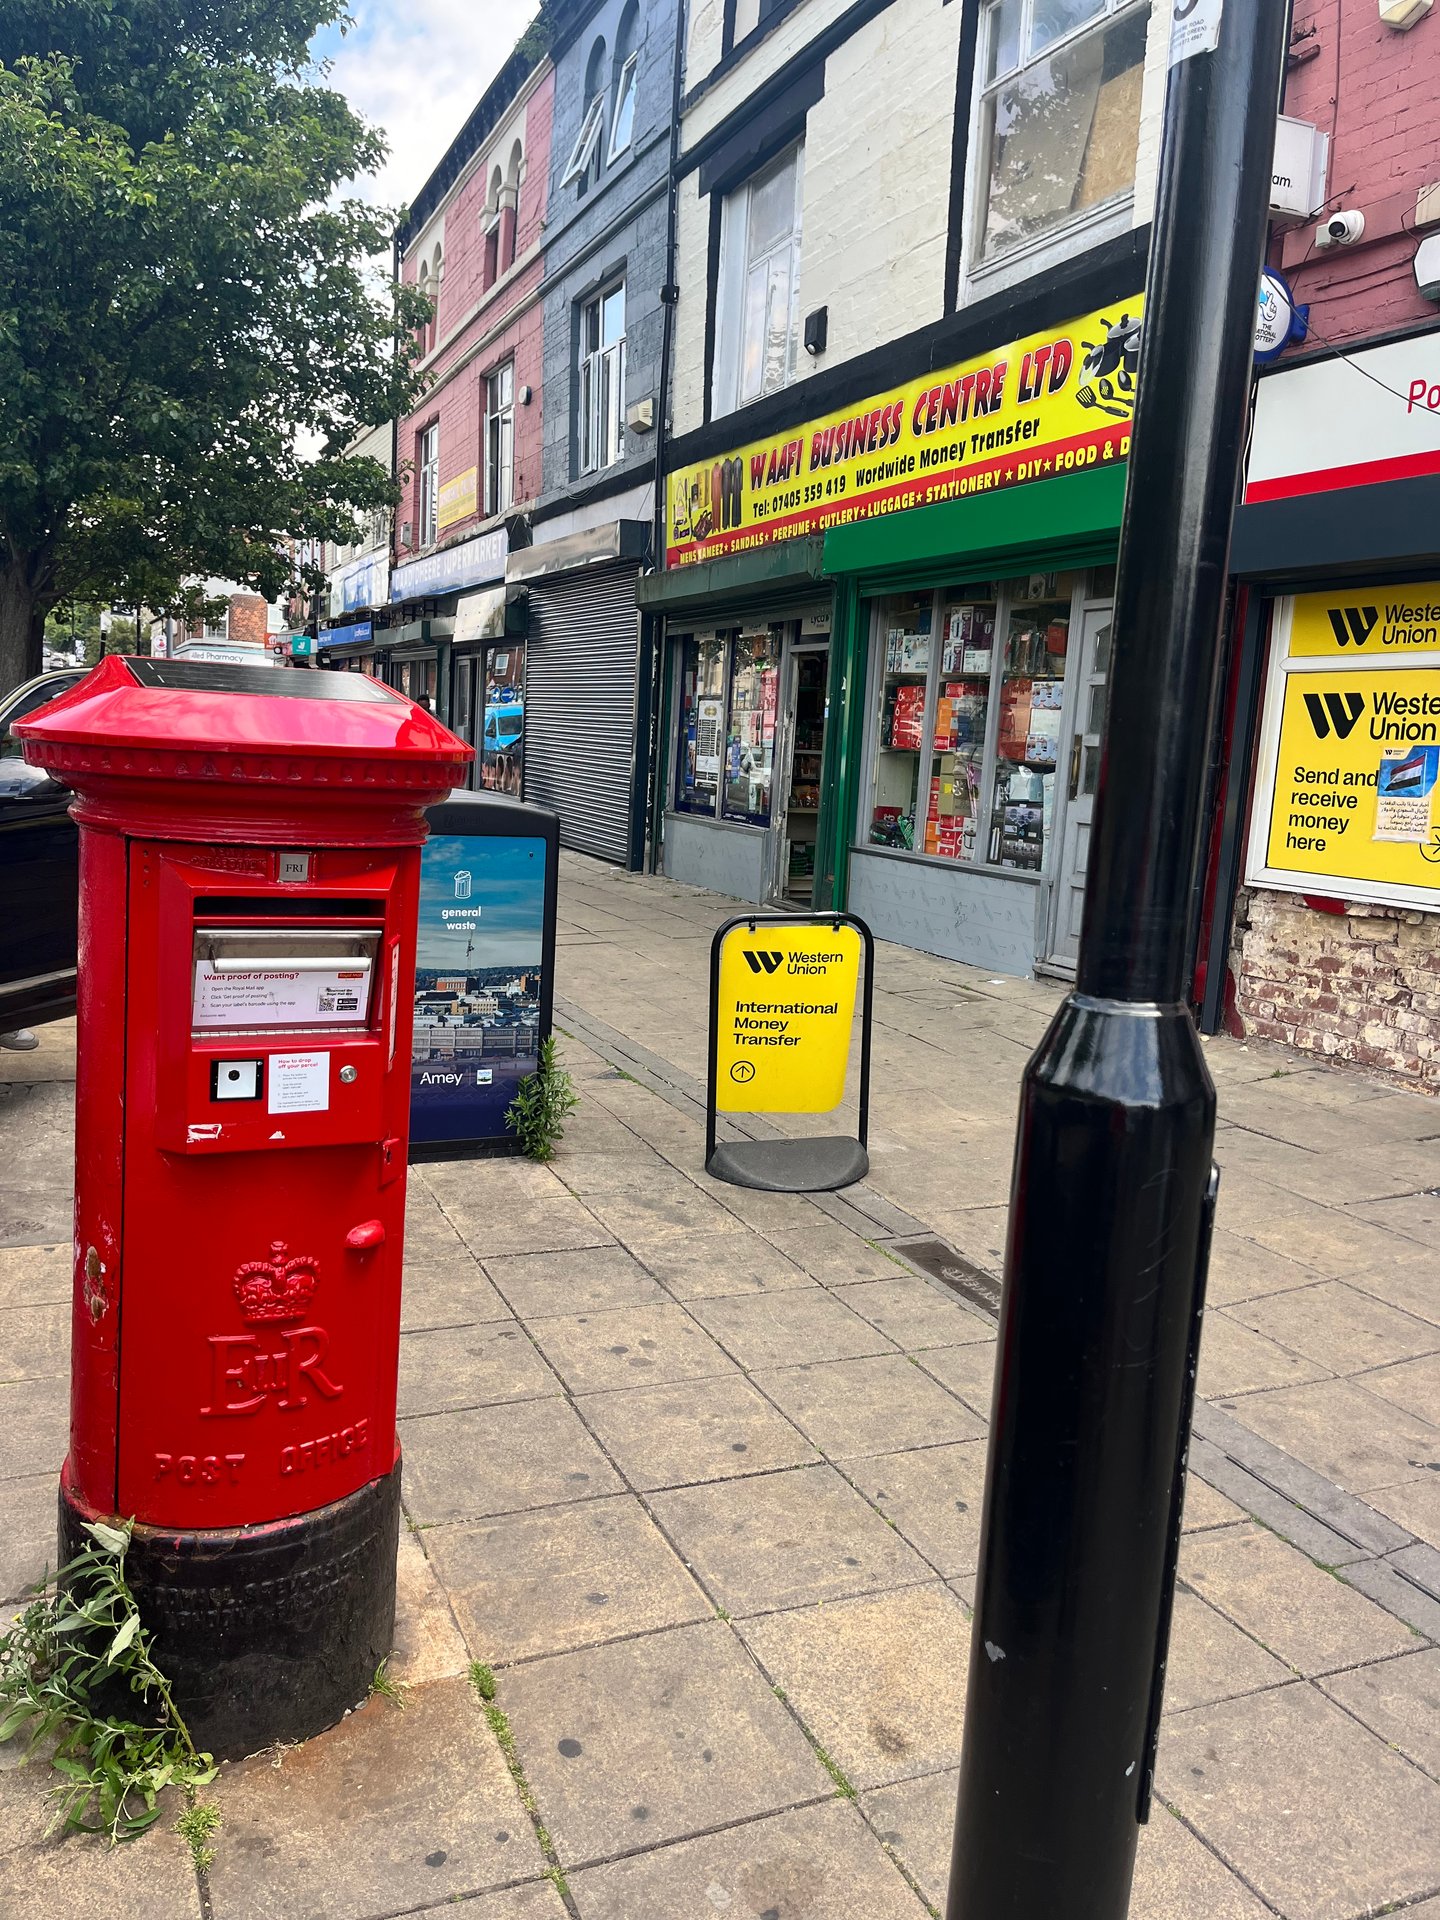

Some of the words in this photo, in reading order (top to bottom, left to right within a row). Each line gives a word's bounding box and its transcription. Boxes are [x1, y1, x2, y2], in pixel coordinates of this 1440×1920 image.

[1256, 328, 1276, 339] ATIONAL
[1262, 323, 1272, 331] THE
[1255, 334, 1274, 344] OTTERY
[750, 438, 804, 492] WAAFI
[809, 400, 904, 473] BUSINESS
[912, 361, 1008, 438] CENTRE
[1017, 339, 1073, 405] LTD
[753, 503, 770, 518] Tel:
[772, 489, 801, 513] 07405
[804, 484, 822, 502] 359
[826, 475, 846, 496] 419
[856, 455, 915, 487] Wordwide
[920, 440, 967, 469] Money
[971, 418, 1040, 452] Transfer
[730, 532, 764, 552] SANDALS
[772, 520, 810, 542] PERFUME
[819, 506, 859, 530] CUTLERY
[868, 493, 915, 516] LUGGAGE
[926, 469, 1002, 503] STATIONERY
[1018, 458, 1042, 481] DIY
[1055, 445, 1098, 472] FOOD
[1102, 440, 1114, 458] &
[443, 533, 503, 576] SUPERMARKET
[1385, 603, 1440, 624] Weste
[1382, 624, 1437, 645] Union
[206, 652, 244, 663] Pharmacy
[1372, 692, 1440, 715] Weste
[1370, 717, 1437, 741] Union
[1294, 766, 1340, 785] Send
[1343, 769, 1380, 787] and
[1291, 791, 1358, 809] receive
[1288, 813, 1350, 835] money
[1286, 832, 1327, 852] here
[286, 864, 304, 872] FRI
[442, 906, 482, 920] general
[446, 920, 476, 930] waste
[788, 952, 843, 963] Western
[227, 973, 250, 981] proof
[264, 972, 300, 980] posting?
[787, 964, 826, 975] Union
[736, 1000, 838, 1014] International
[734, 1017, 789, 1032] Money
[733, 1033, 801, 1046] Transfer
[420, 1071, 463, 1086] Amey
[154, 1452, 246, 1484] POST
[280, 1418, 369, 1475] OFFICE
